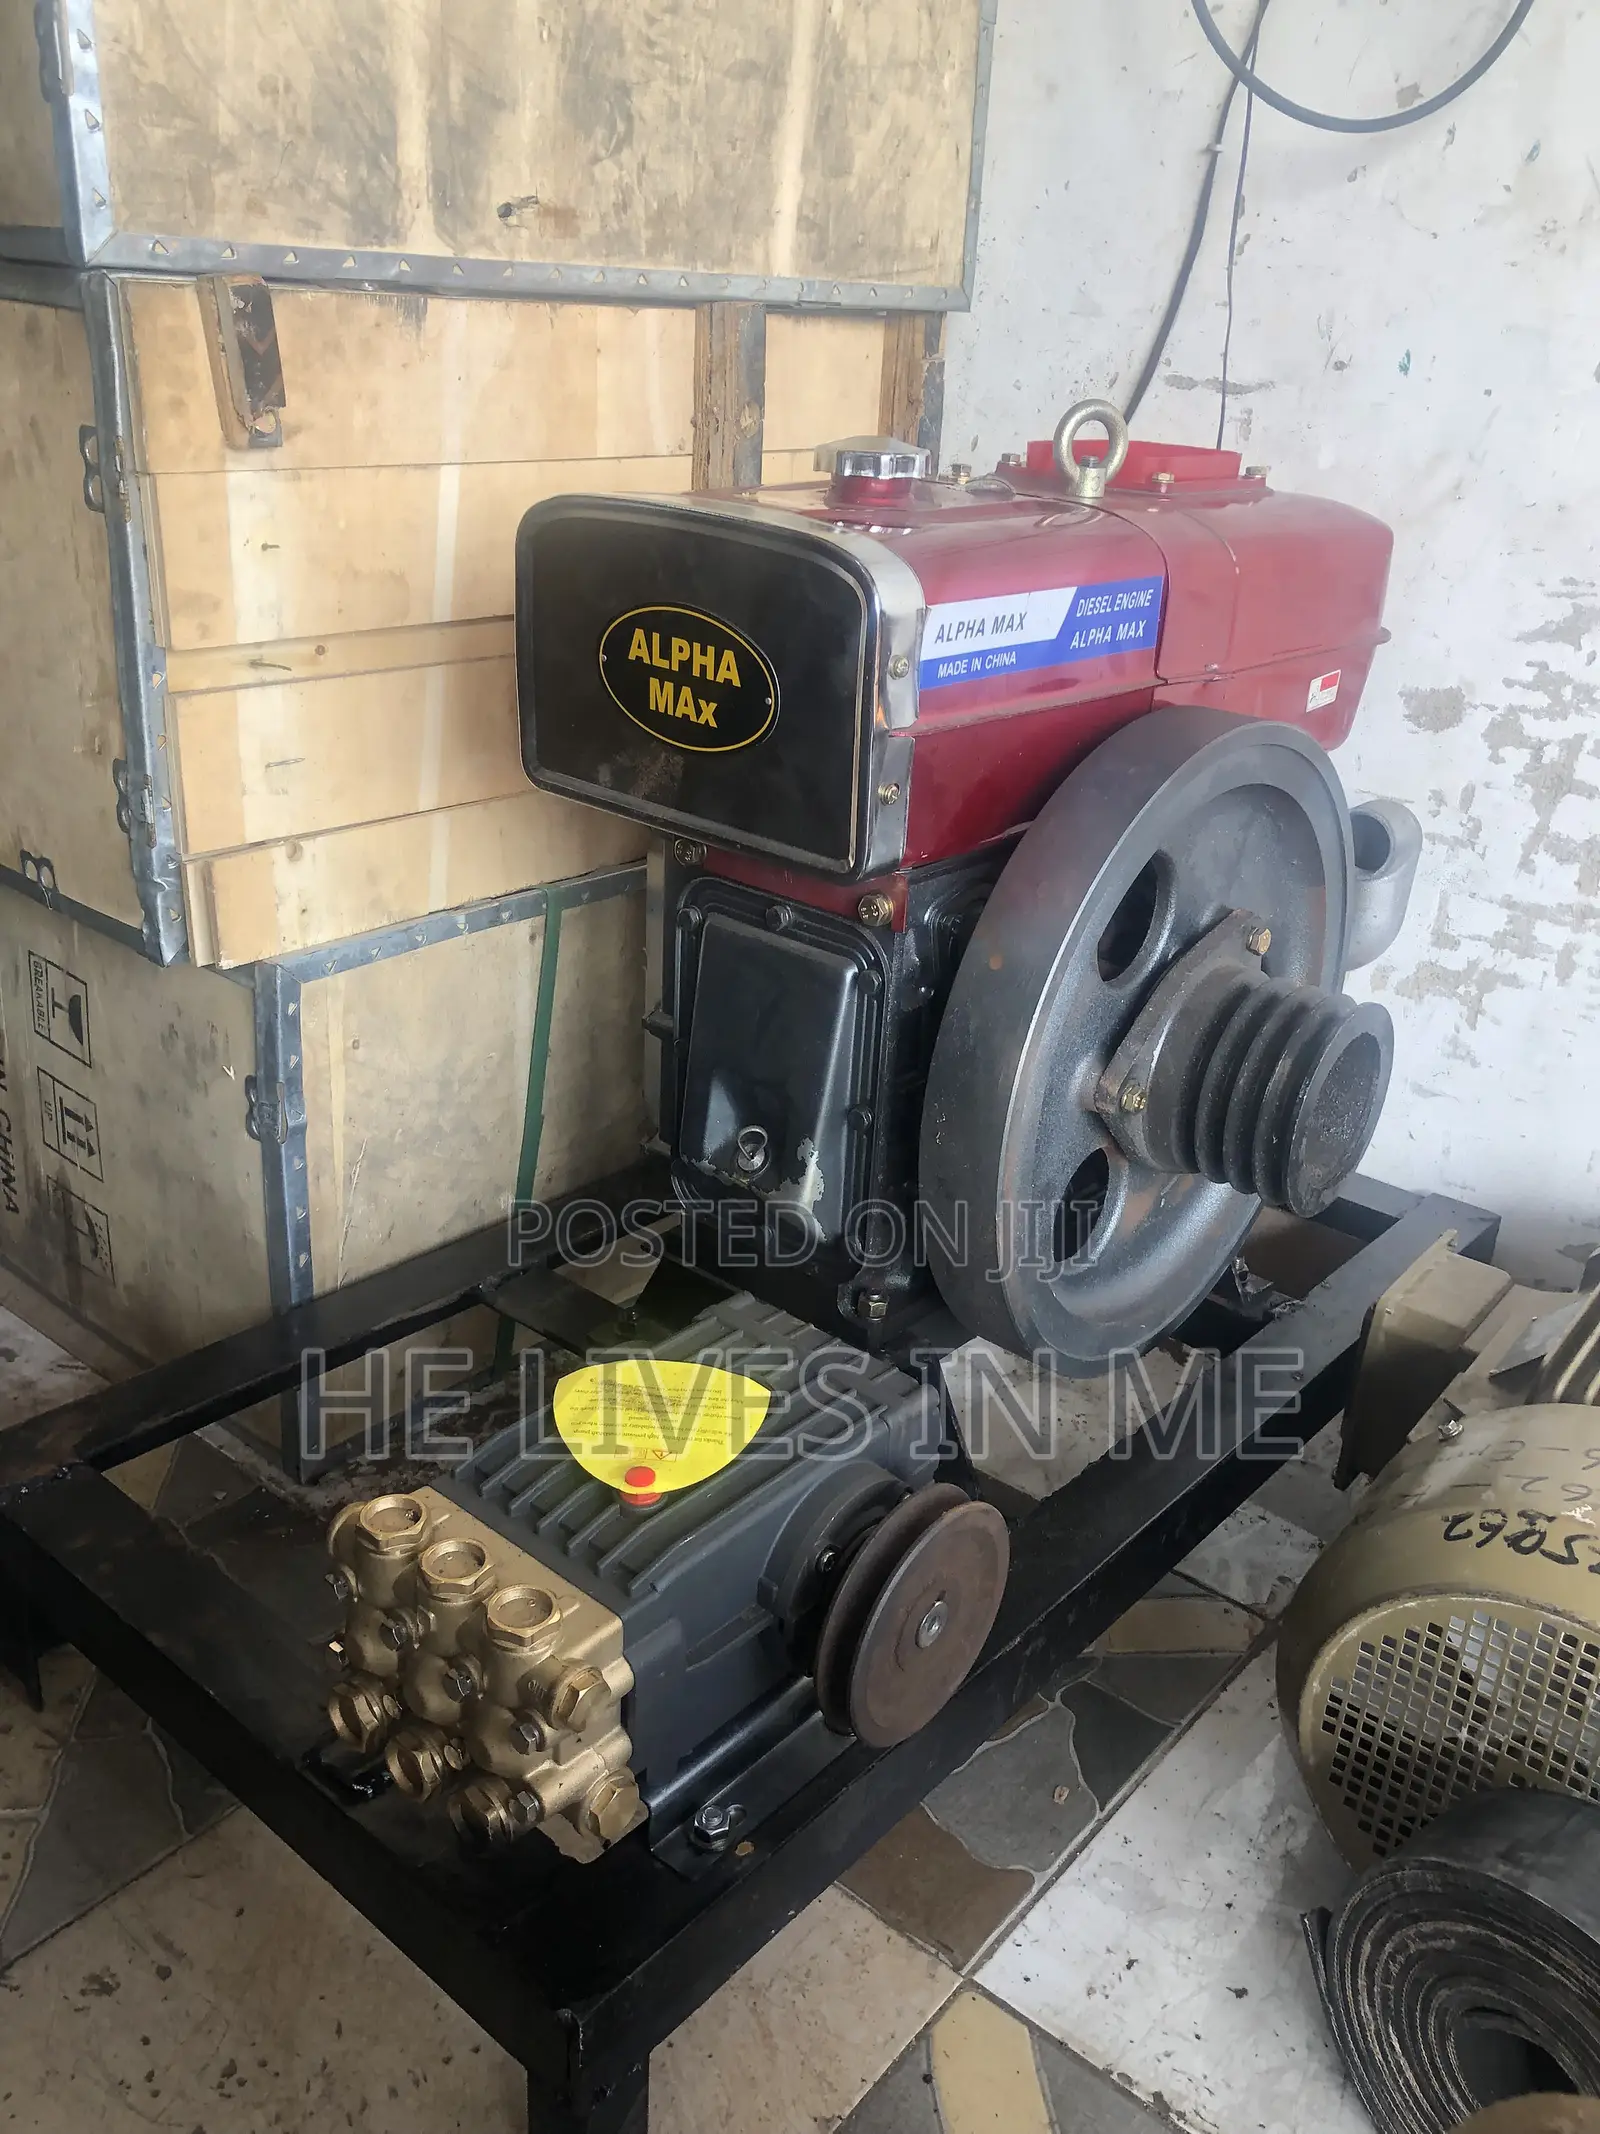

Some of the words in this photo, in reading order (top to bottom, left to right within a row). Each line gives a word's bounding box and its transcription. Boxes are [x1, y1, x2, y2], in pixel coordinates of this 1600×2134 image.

[1076, 594, 1113, 617] DIESEL
[1113, 589, 1154, 613] ENGINE
[935, 618, 985, 644] ALPHA
[991, 611, 1027, 634] MAX
[1070, 624, 1112, 650] ALPHA
[1116, 619, 1147, 640] MAX
[628, 627, 741, 688] ALPHA
[937, 660, 968, 679] MADE
[971, 658, 981, 672] IN
[985, 651, 1017, 669] CHINA
[33, 960, 45, 1030] BREAKABLE
[44, 1100, 54, 1122] UP
